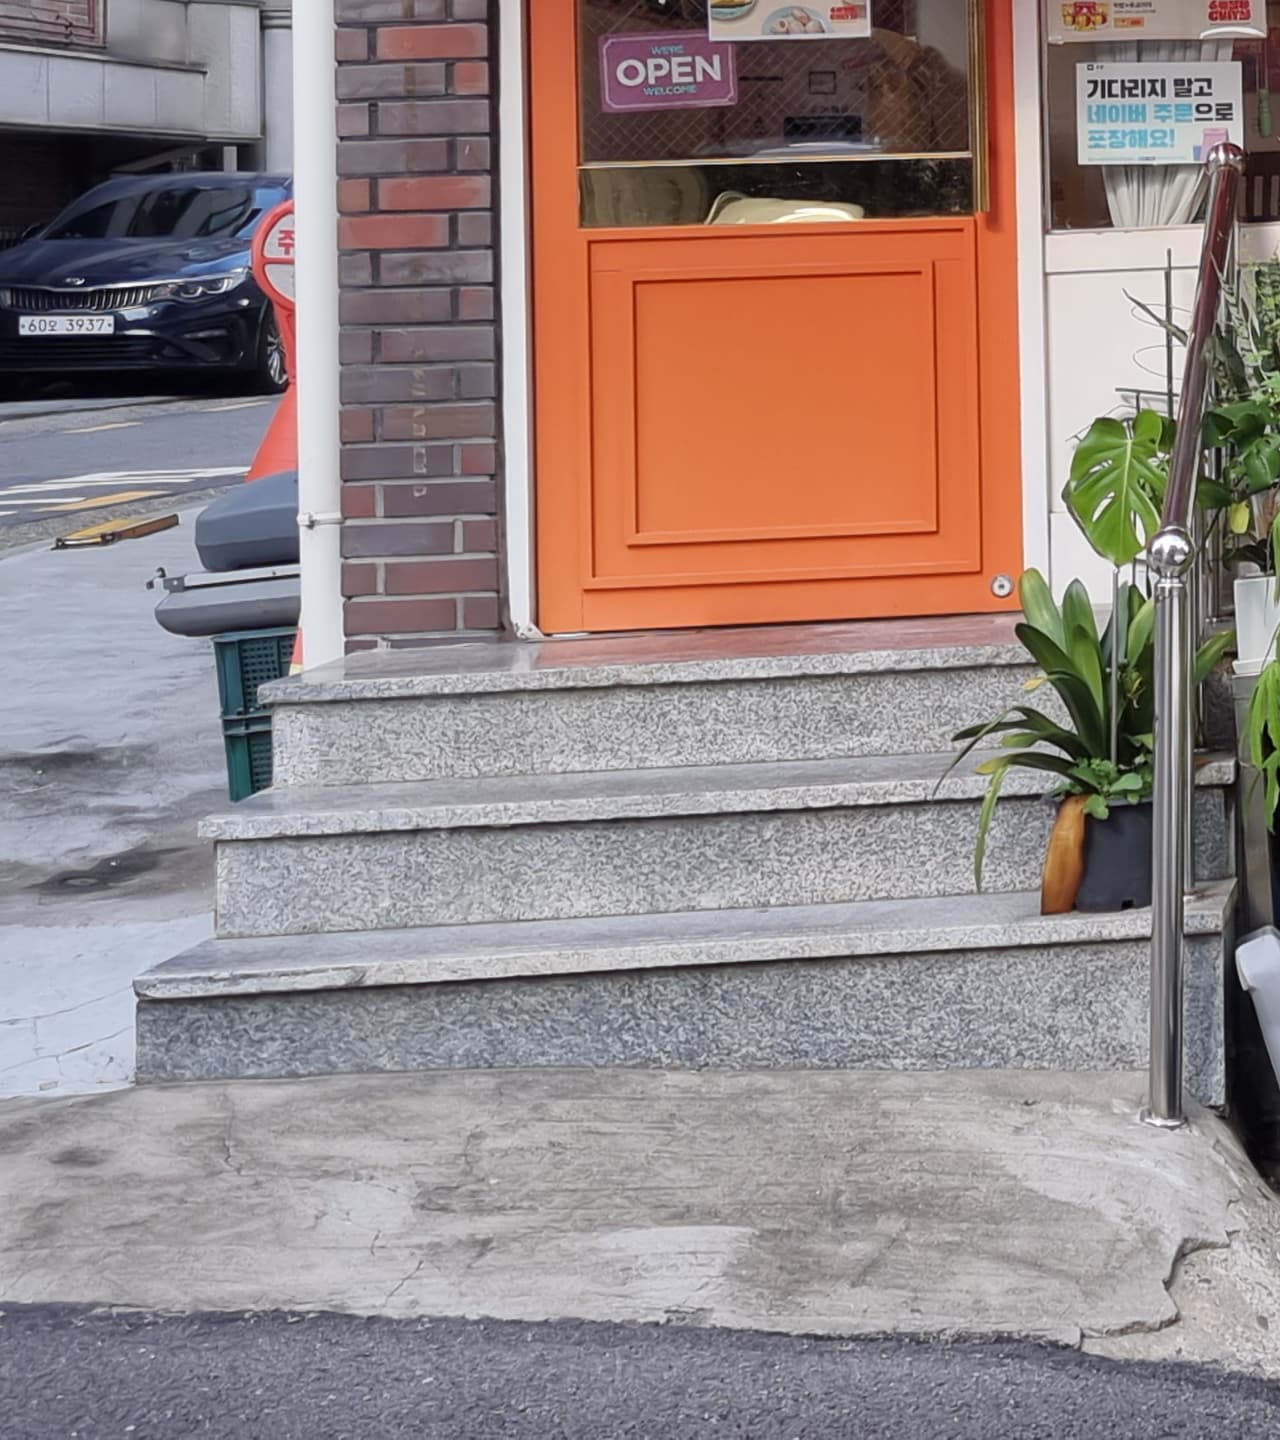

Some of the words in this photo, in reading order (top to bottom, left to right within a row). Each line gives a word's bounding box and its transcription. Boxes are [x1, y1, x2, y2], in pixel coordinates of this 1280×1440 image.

[616, 54, 721, 87] OPEN
[643, 85, 697, 96] WELCOME
[1087, 78, 1166, 99] 기다리지
[1173, 78, 1213, 98] 말고
[1087, 103, 1147, 123] 네이버
[1153, 102, 1233, 123] 주문으로
[1087, 129, 1175, 149] 포장해요!
[65, 319, 105, 332] 3937
